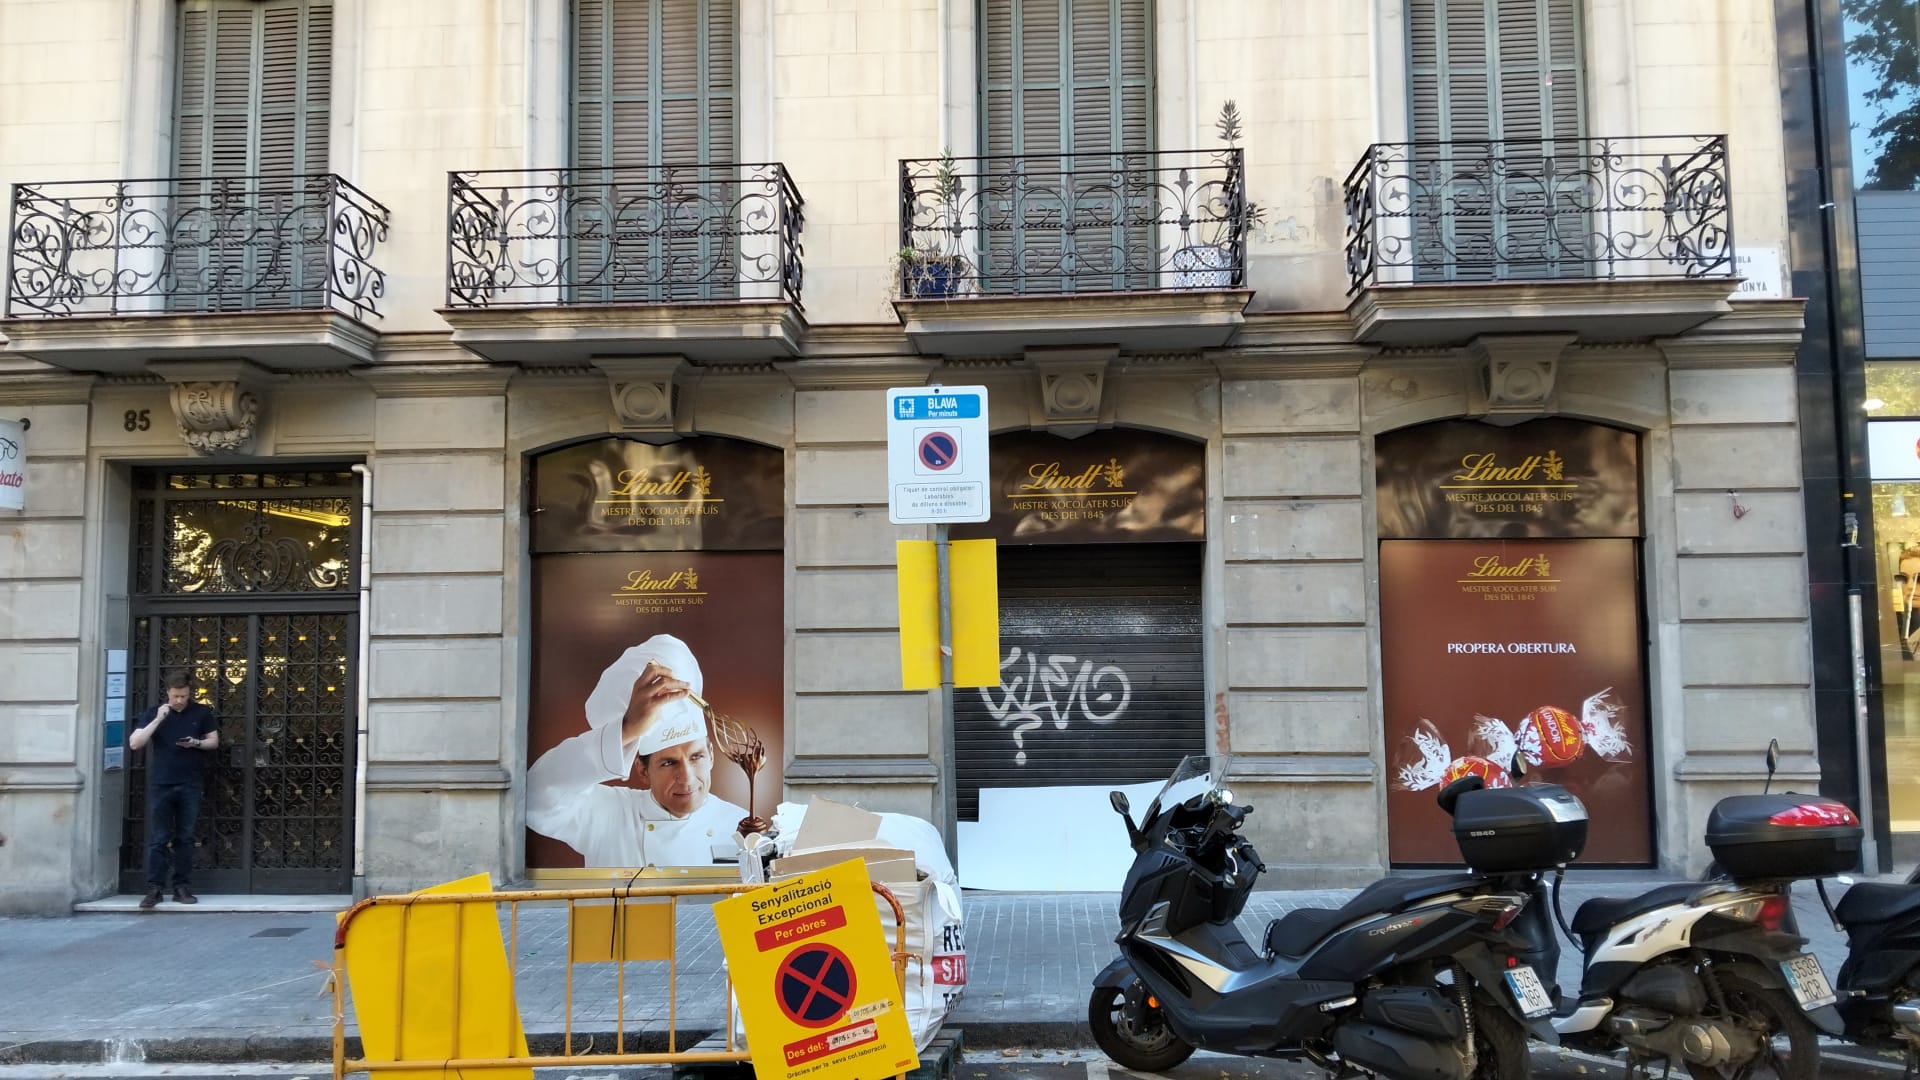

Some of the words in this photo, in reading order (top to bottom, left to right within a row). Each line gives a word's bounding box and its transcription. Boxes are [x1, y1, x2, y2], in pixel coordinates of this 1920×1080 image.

[927, 397, 958, 409] BLAVA
[123, 409, 151, 432] 85
[1452, 453, 1543, 481] Lindt
[609, 469, 692, 496] Lindt
[1019, 462, 1103, 490] Lindt
[1012, 500, 1049, 510] MESTRE
[1051, 499, 1110, 509] XOCOLATER
[1445, 492, 1484, 502] MESTRE
[1485, 492, 1548, 502] XOCOLATER
[601, 506, 636, 516] MESTRE
[638, 506, 696, 516] XOCOLATER
[1041, 512, 1059, 520] DES
[1061, 511, 1079, 520] DEL
[1082, 511, 1105, 519] 1845
[1475, 504, 1496, 513] DES
[1497, 504, 1516, 513] DEL
[1519, 503, 1544, 513] 1845
[628, 517, 647, 526] DES
[648, 517, 666, 526] DEL
[669, 517, 691, 526] 1845
[1467, 555, 1534, 577] Lindt
[619, 569, 684, 590] Lindt
[1461, 585, 1492, 593] MESTRE
[1492, 585, 1539, 593] XOCOLATER
[1484, 593, 1500, 601] DES
[615, 598, 643, 606] MESTRE
[644, 597, 688, 605] XOCOLATER
[666, 605, 683, 613] 1845
[1447, 642, 1506, 654] PROPERA
[1507, 642, 1577, 653] OBERTURA
[660, 725, 692, 743] Lindt
[751, 878, 833, 912] Senyalització
[758, 893, 833, 925] Excepcional
[774, 926, 794, 941] Per
[796, 917, 827, 936] obres
[1791, 958, 1820, 979] 5539
[1800, 979, 1825, 1001] HCR
[786, 1050, 806, 1060] Des
[807, 1042, 825, 1053] del:
[811, 1063, 822, 1073] per
[831, 1057, 847, 1065] seva
